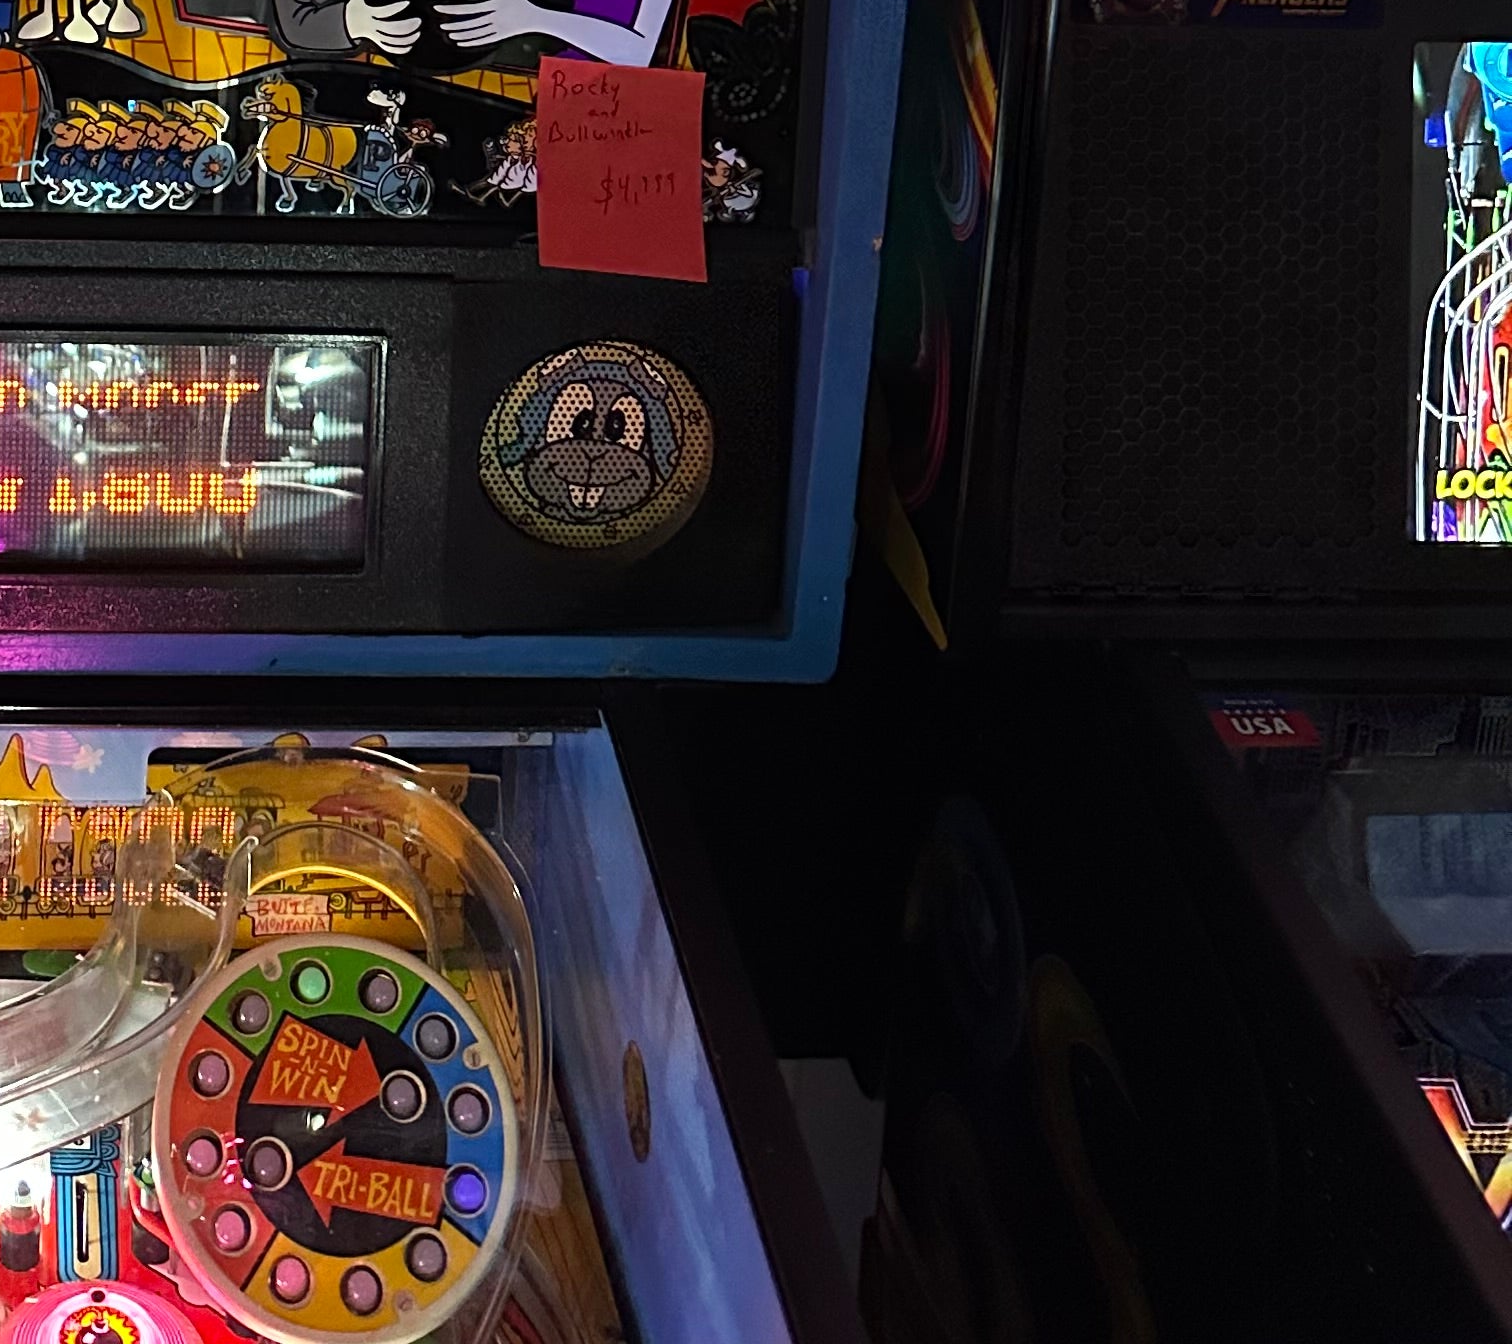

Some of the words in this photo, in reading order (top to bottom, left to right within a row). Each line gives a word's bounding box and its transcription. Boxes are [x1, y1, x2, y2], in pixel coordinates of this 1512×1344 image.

[551, 69, 621, 102] Rocky
[588, 99, 620, 118] and
[1229, 717, 1295, 734] USA
[255, 916, 326, 932] MONTANA
[276, 1023, 352, 1072] SPIN
[269, 1060, 347, 1104] WIN
[313, 1160, 434, 1218] TRI-BALL
